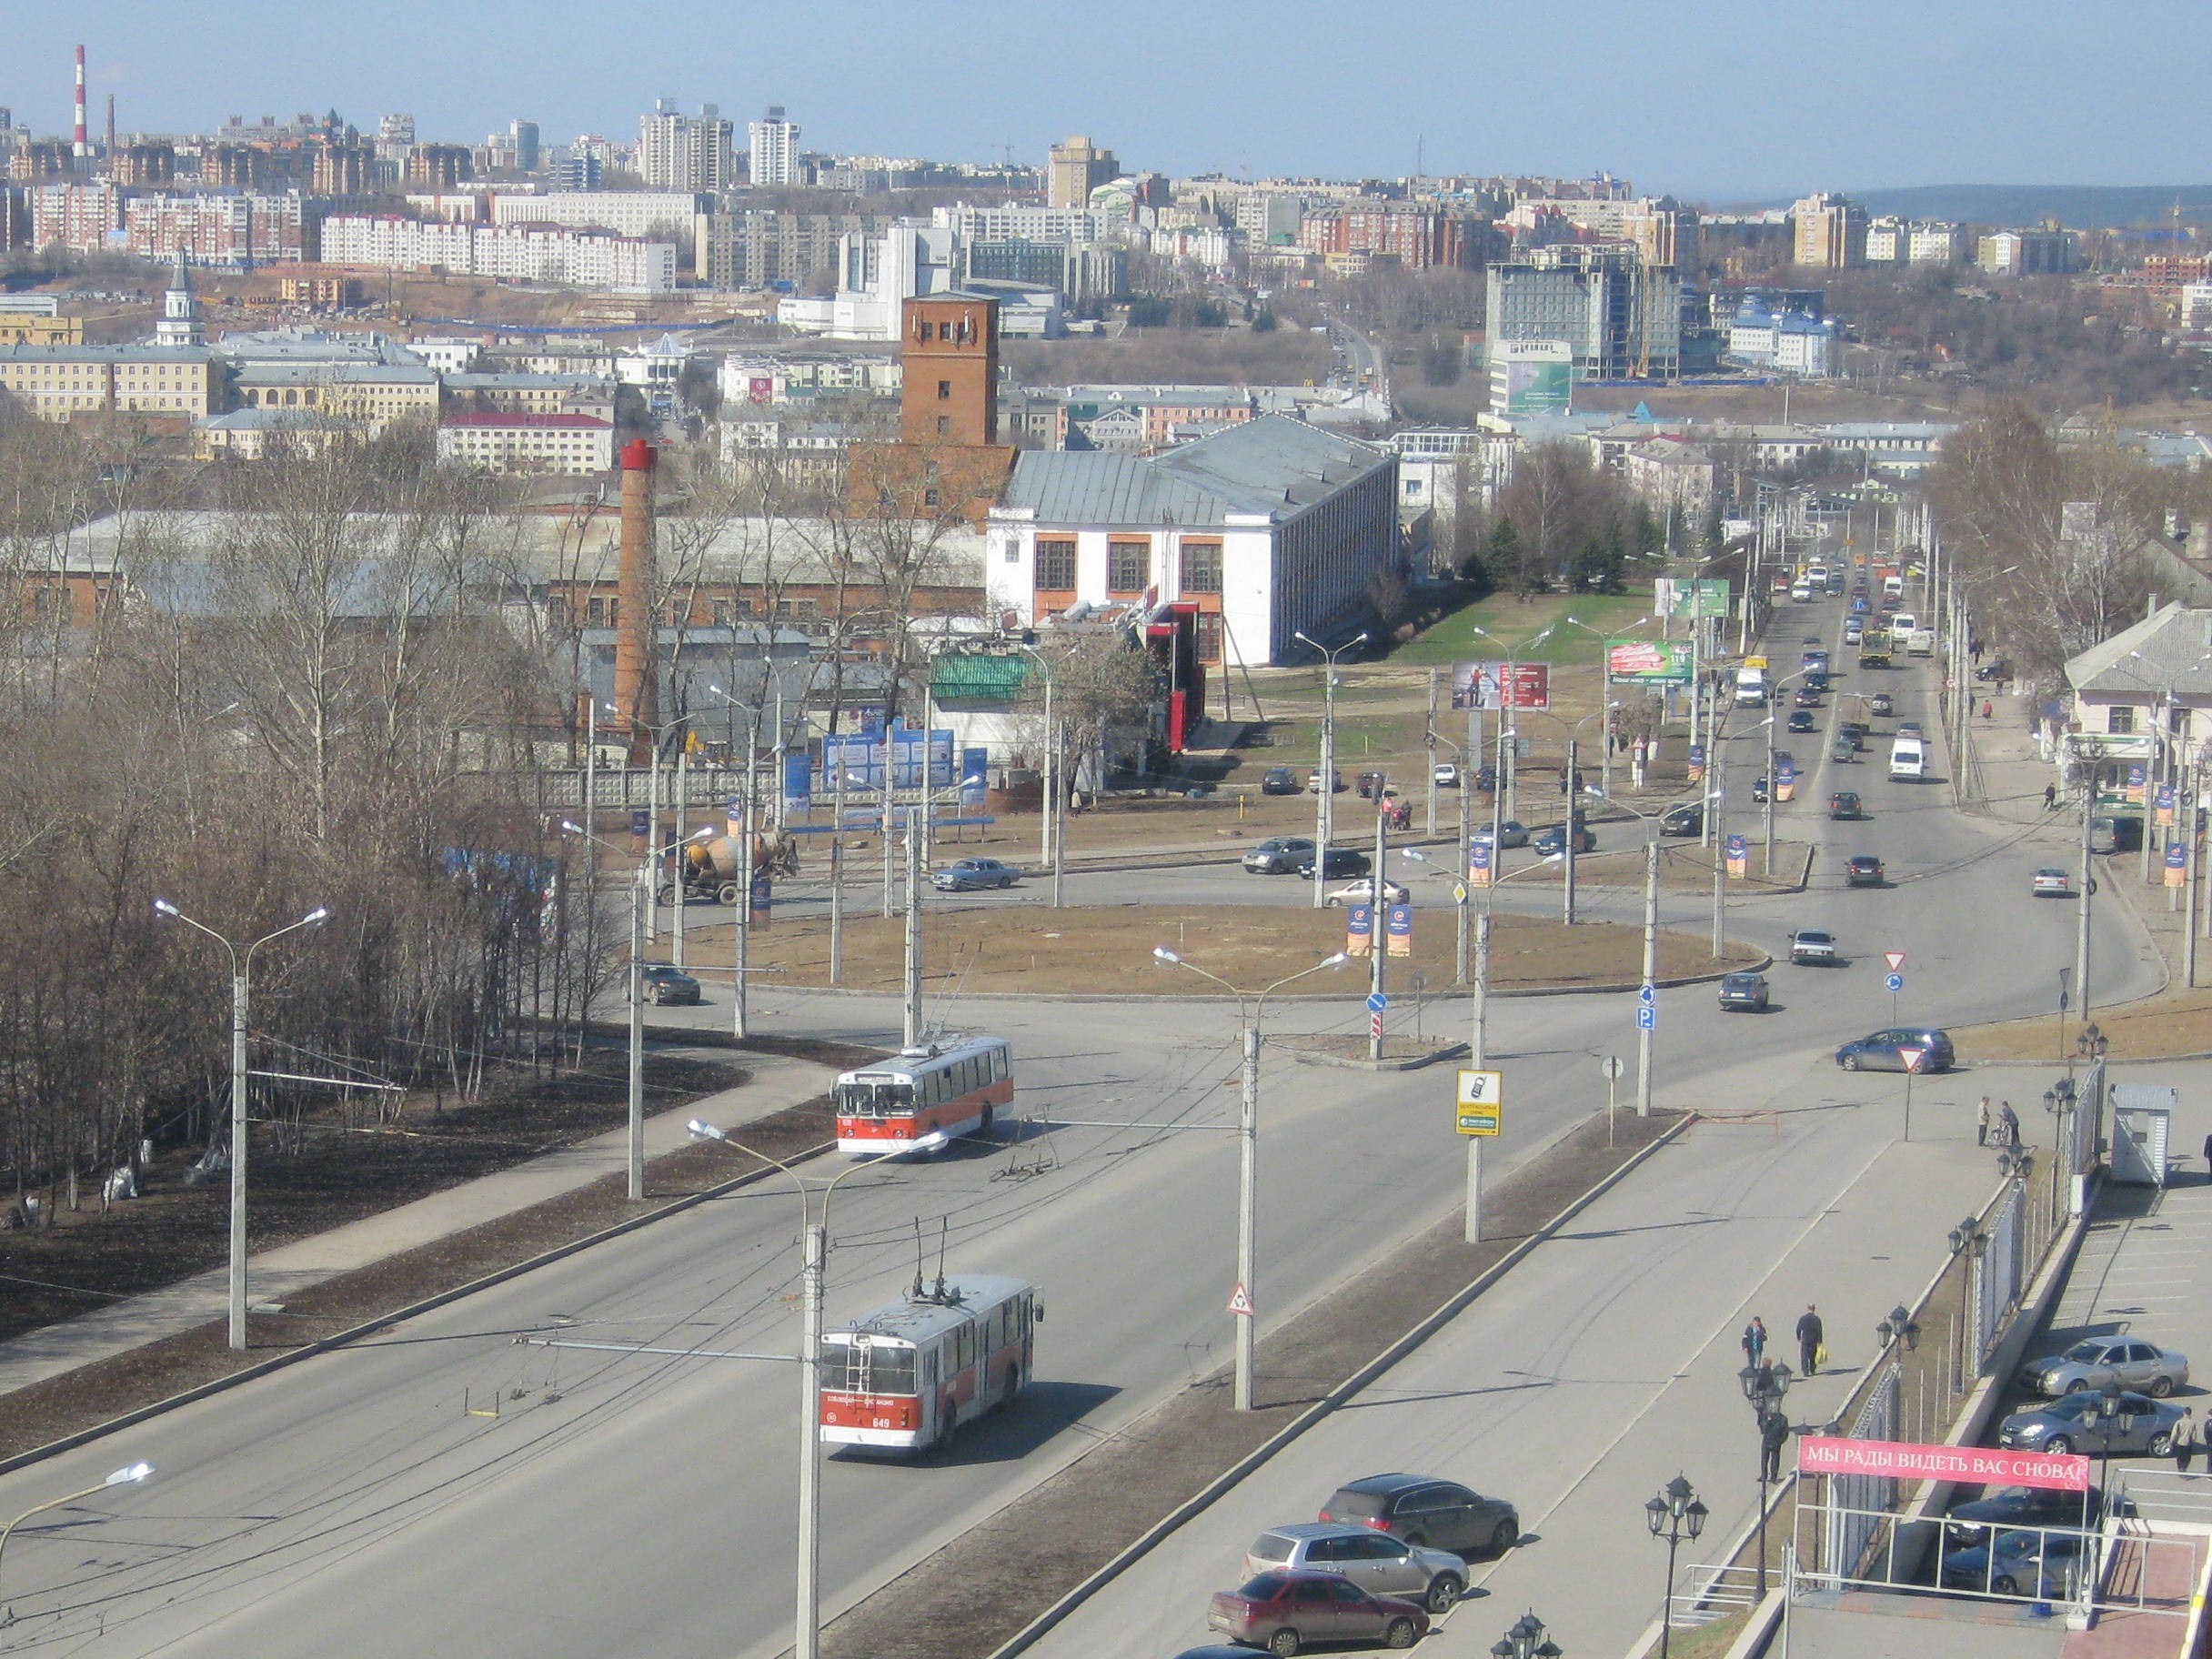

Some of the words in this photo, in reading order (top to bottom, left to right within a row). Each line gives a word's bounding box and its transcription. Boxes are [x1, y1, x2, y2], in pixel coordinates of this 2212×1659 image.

[1640, 1010, 1650, 1026] P
[872, 1418, 890, 1428] 649
[1807, 1445, 1839, 1463] МЫ
[1845, 1448, 1893, 1467] РАДЫ
[1898, 1453, 1967, 1473] ВИДЕТЬ
[1974, 1459, 2007, 1475] ВАС
[2013, 1462, 2081, 1481] СНОВА!
